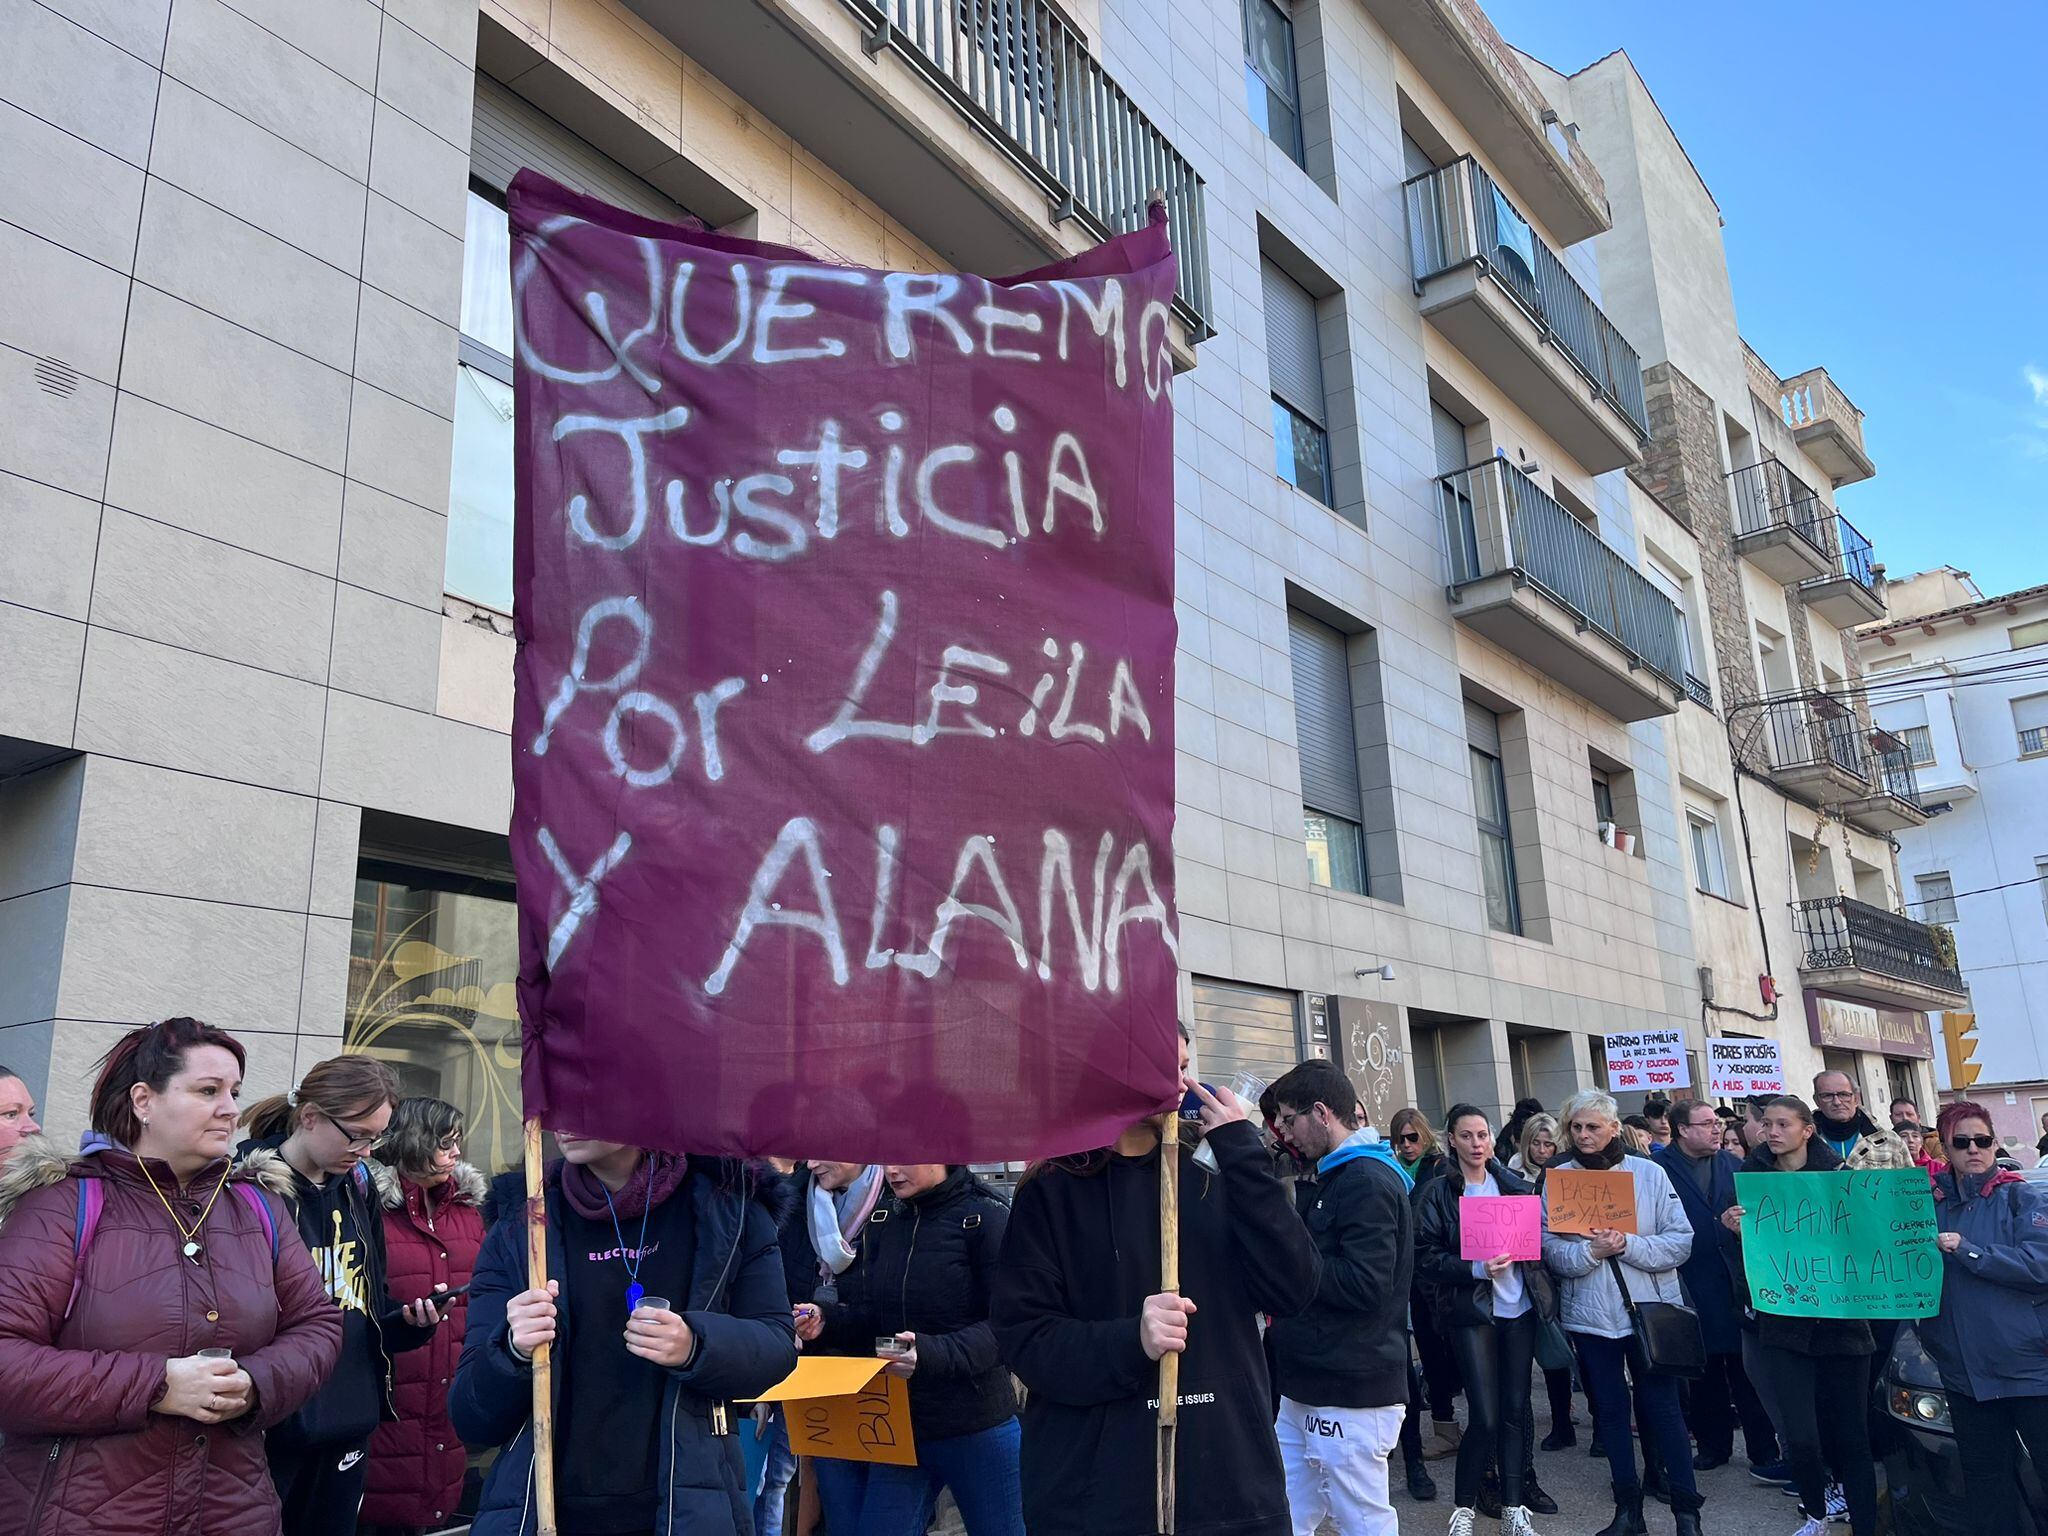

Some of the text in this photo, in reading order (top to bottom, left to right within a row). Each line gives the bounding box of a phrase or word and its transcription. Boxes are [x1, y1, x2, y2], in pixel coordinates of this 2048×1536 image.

[533, 595, 746, 786] Por
[537, 816, 1178, 995] Y ALANA
[1841, 1008, 1915, 1045] BAR LA CATALANA
[1607, 1035, 1640, 1048] ENTORNO
[1622, 1049, 1632, 1058] LA
[1660, 1046, 1671, 1055] MAL
[1712, 1044, 1742, 1059] PADRES
[1637, 1060, 1644, 1069] Y
[1717, 1064, 1724, 1073] Y
[1728, 1064, 1773, 1074] XENOFOBOS
[1619, 1072, 1675, 1086] PARA TODOS
[1712, 1079, 1720, 1090] A
[1560, 1178, 1615, 1203] BASTA
[1473, 1202, 1524, 1226] STOP
[1577, 1200, 1604, 1226] YA
[1755, 1195, 1851, 1236] ALANA
[1890, 1219, 1937, 1232] GUERRERA
[1464, 1227, 1535, 1251] BULLYING
[1769, 1249, 1933, 1284] VUELA ALTO
[1147, 1393, 1215, 1409] FUE ISSUES
[804, 1406, 833, 1445] NO
[1305, 1414, 1343, 1438] NASA
